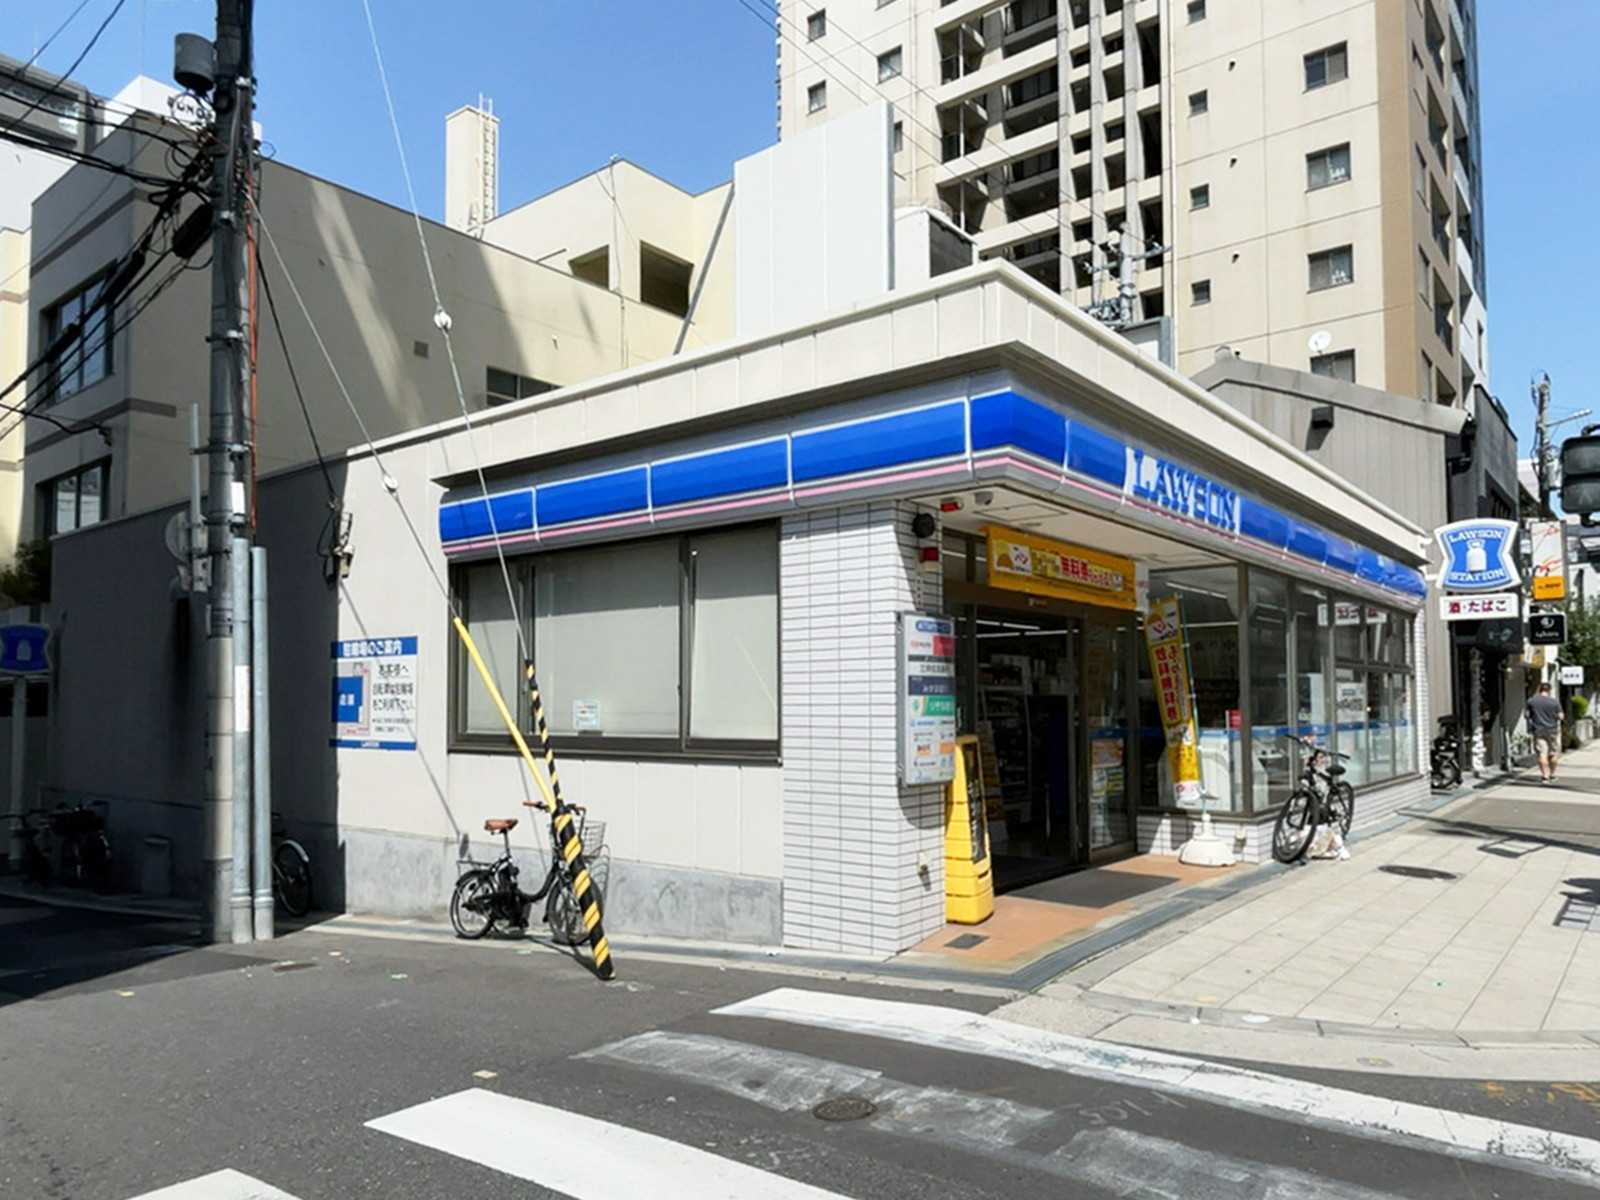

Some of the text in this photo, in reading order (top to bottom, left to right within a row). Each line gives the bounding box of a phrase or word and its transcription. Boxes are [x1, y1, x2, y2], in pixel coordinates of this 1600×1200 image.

[1133, 448, 1235, 529] LAWSON
[1449, 529, 1503, 543] LAWSON
[1450, 569, 1506, 583] STATION
[1448, 600, 1507, 615] 酒・たばこ
